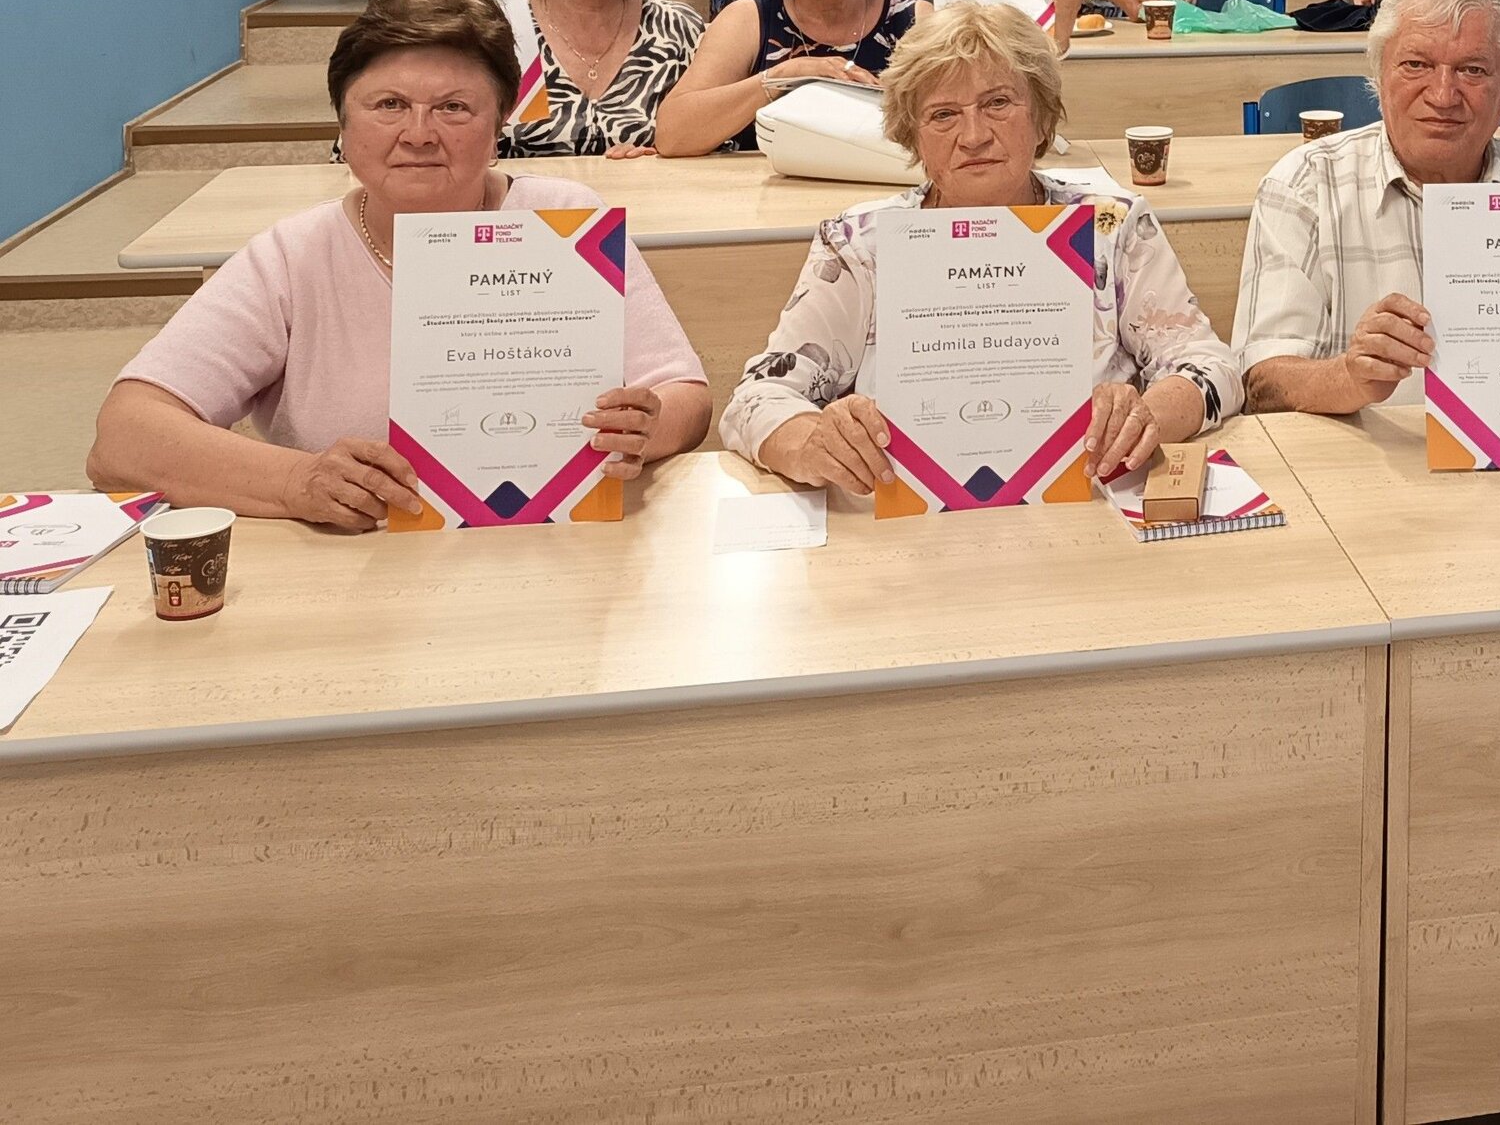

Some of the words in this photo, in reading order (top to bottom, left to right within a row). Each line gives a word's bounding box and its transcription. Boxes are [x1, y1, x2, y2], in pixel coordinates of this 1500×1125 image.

[469, 268, 553, 286] PAMÄTNÝ
[948, 262, 1027, 280] PAMÄTNÝ
[911, 337, 976, 353] Ľudmila
[983, 334, 1060, 352] Budayová
[446, 349, 476, 362] Eva
[483, 345, 572, 360] Hoštáková
